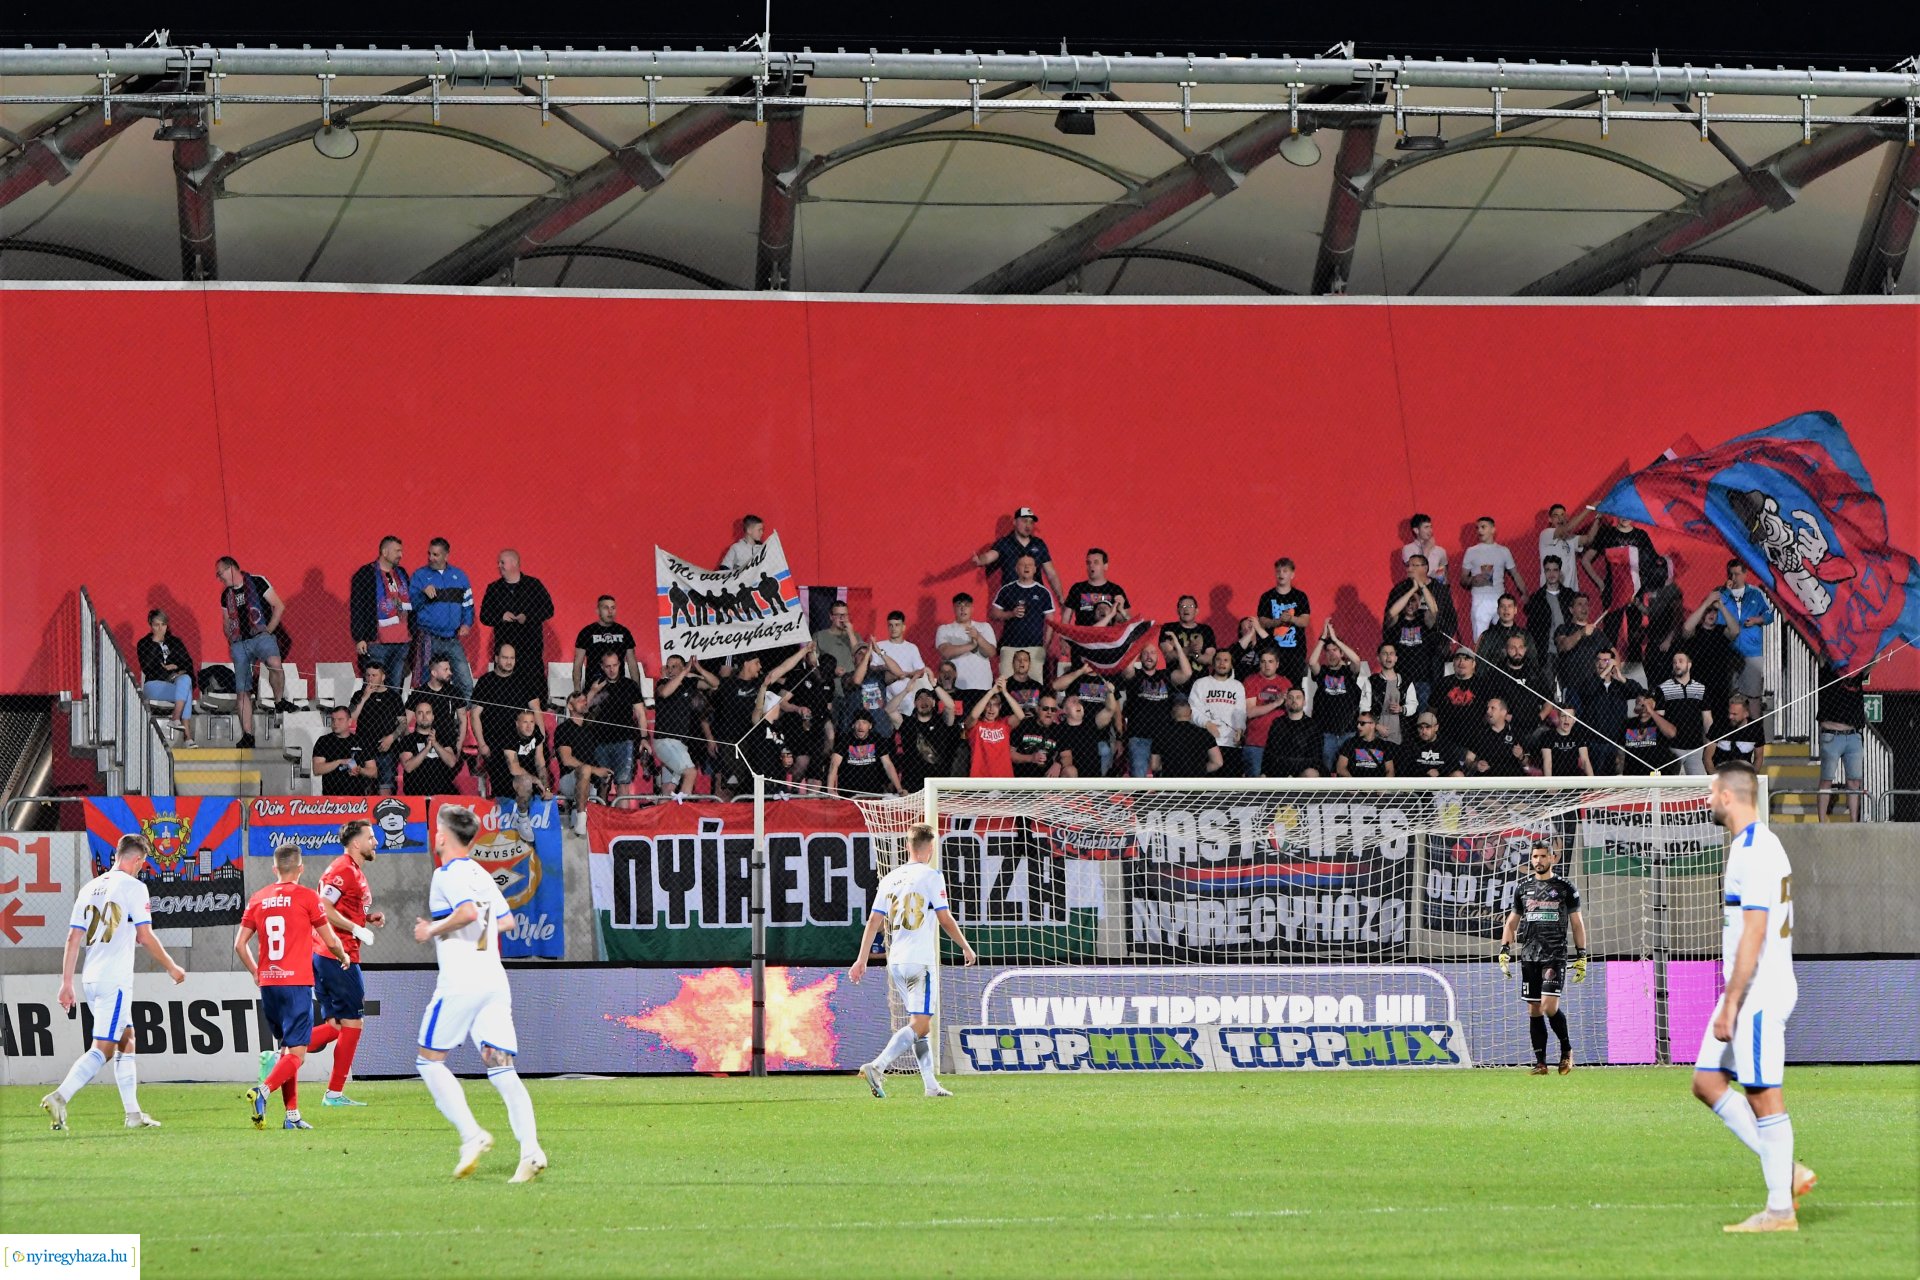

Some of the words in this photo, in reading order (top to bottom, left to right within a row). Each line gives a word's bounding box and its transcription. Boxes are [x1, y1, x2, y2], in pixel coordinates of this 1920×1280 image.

[663, 638, 676, 651] a
[679, 611, 804, 653] Nyíregyháza!
[255, 799, 286, 817] Vén
[289, 798, 369, 817] Tinédzserek
[482, 800, 551, 832] Schol
[149, 892, 242, 914] EGYHÁZA
[1485, 879, 1518, 910] FA
[84, 900, 122, 947] 29
[1131, 887, 1407, 947] NYÍREGYHÁZA
[265, 915, 286, 961] 8
